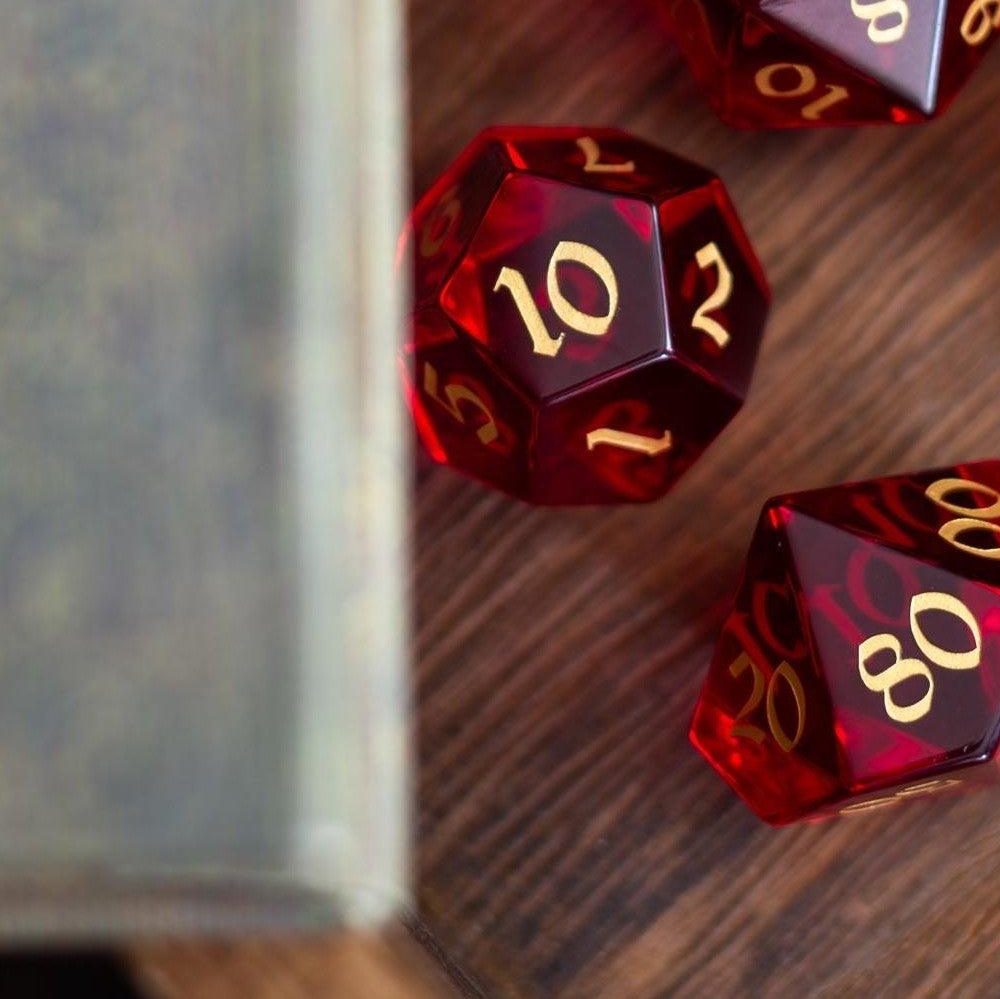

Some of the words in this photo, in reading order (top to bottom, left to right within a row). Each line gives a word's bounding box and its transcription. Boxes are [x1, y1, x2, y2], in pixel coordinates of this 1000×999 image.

[755, 63, 849, 120] 10
[492, 240, 619, 358] 10
[691, 241, 734, 349] 2
[423, 361, 499, 445] 5
[586, 428, 673, 457] 1
[727, 650, 807, 754] 20
[858, 592, 982, 724] 80
